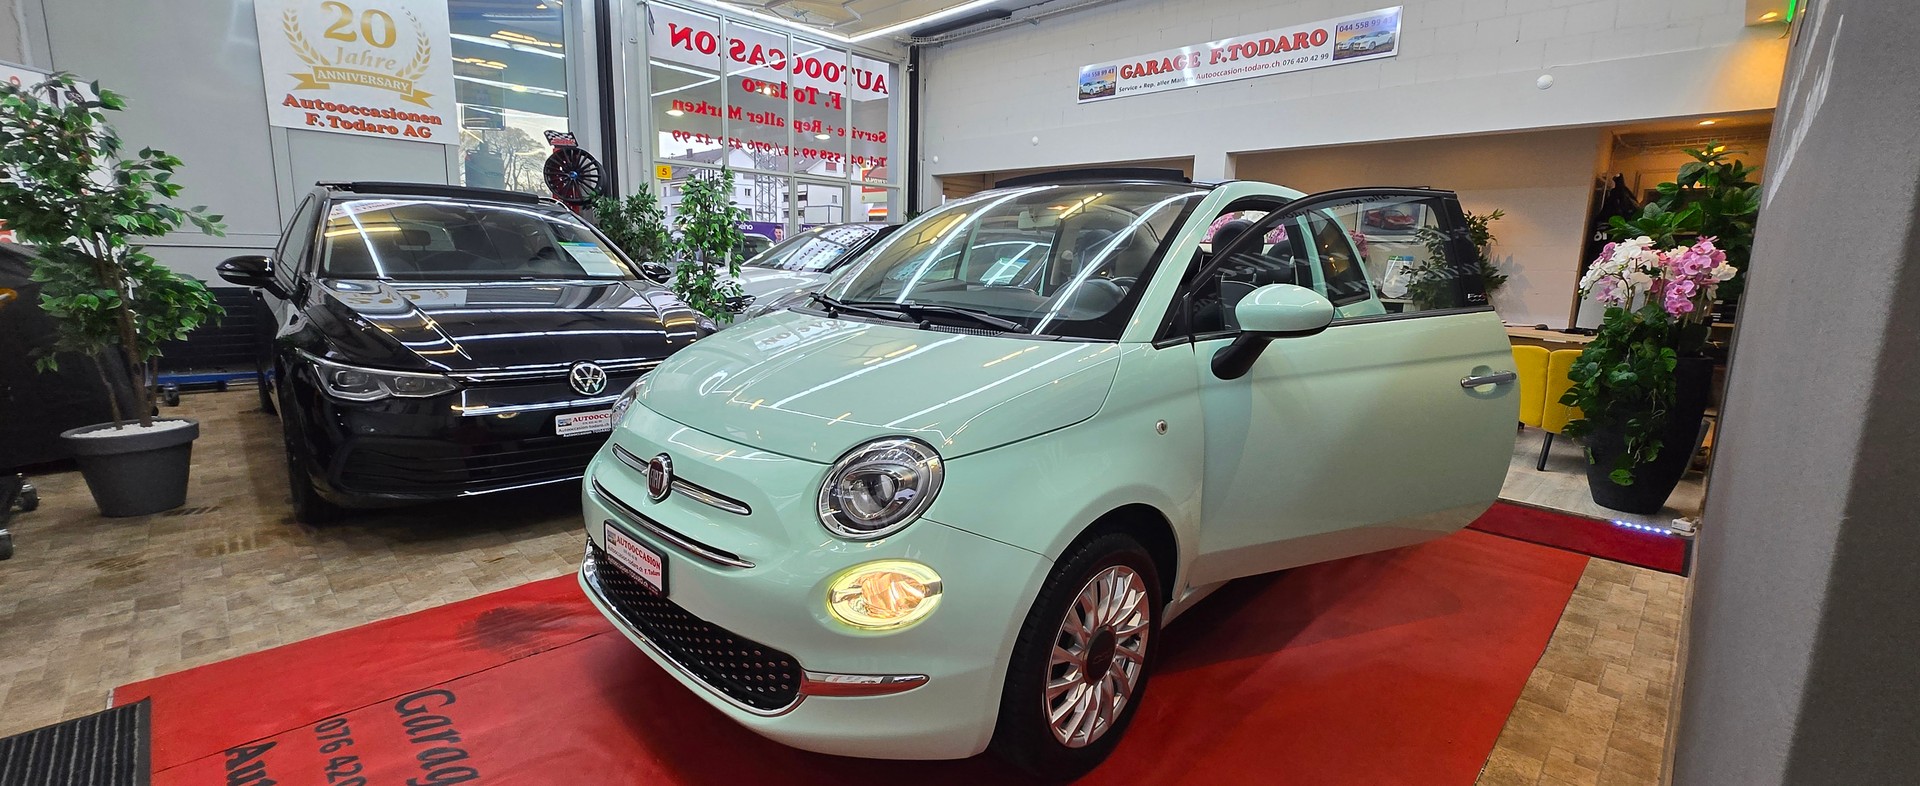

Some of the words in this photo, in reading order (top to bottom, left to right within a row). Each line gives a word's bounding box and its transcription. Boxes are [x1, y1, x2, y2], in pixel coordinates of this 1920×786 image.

[320, 1, 397, 48] 20
[1355, 20, 1369, 30] 558
[336, 46, 397, 70] Jahre
[1119, 51, 1201, 80] GARAGE
[1209, 28, 1329, 65] F.TODARO
[317, 69, 410, 91] ANNIVERSARY
[1118, 84, 1138, 92] Service
[1196, 59, 1281, 80] Autooccasion-todaro.ch
[1282, 58, 1294, 67] 076
[1295, 56, 1309, 65] 420
[1309, 54, 1319, 62] 42
[1320, 52, 1329, 60] 99
[282, 93, 442, 125] Autooccasionen
[304, 111, 325, 127] F.
[325, 114, 399, 134] Todaro
[402, 124, 432, 138] AG
[661, 167, 668, 176] 5
[573, 413, 612, 423] AUTOOCC
[650, 468, 663, 490] FIAT
[617, 535, 661, 571] AUTOOCCASION
[313, 717, 355, 754] 076
